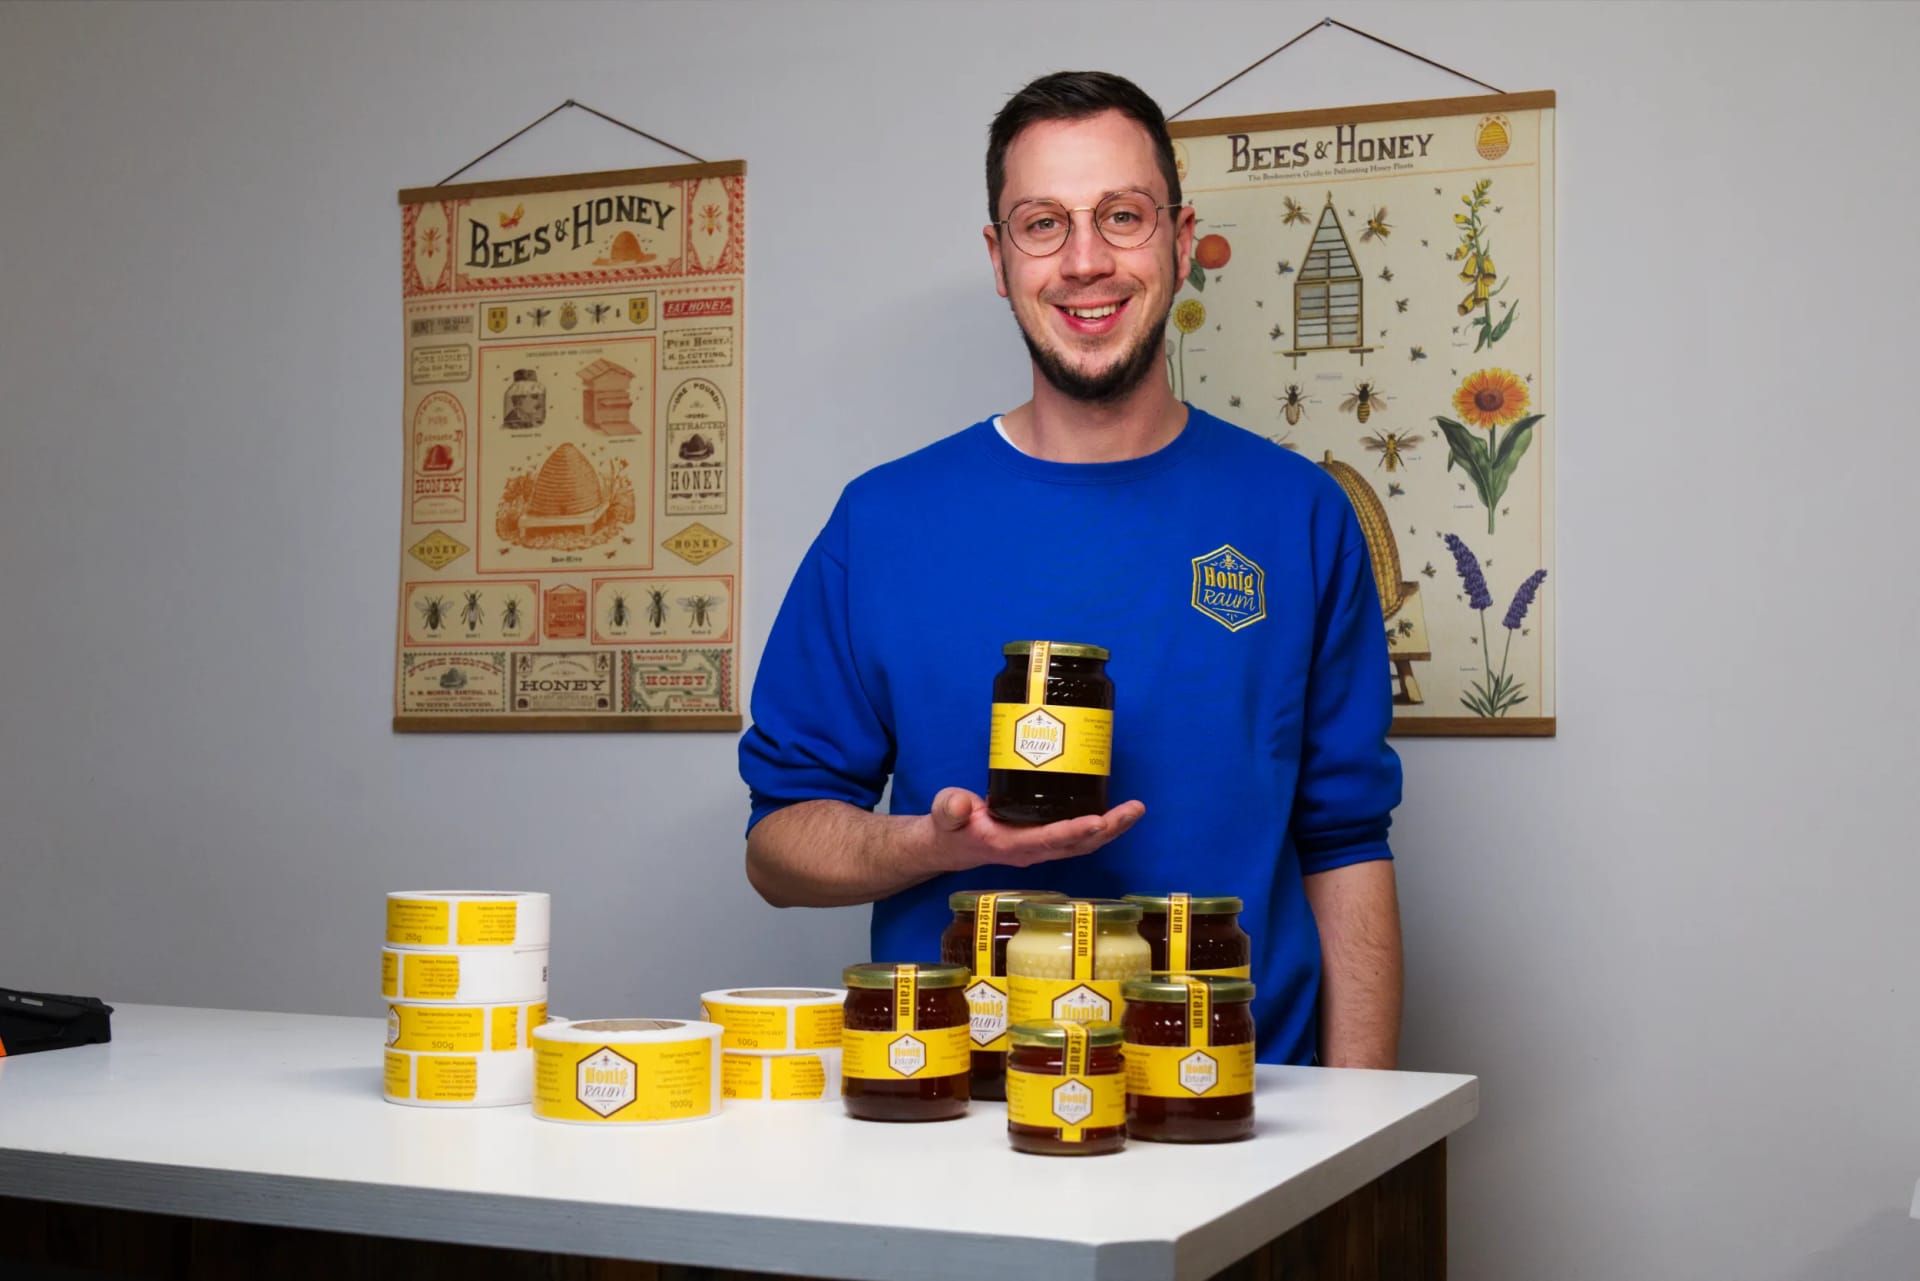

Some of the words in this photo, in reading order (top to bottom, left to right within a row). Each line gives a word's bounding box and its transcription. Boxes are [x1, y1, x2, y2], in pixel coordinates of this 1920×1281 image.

[1226, 133, 1310, 173] BEES
[1314, 141, 1333, 160] &
[1334, 124, 1434, 164] HONEY
[464, 218, 552, 268] BEES
[554, 217, 570, 242] &
[571, 195, 675, 250] HONEY
[667, 302, 688, 313] EAT
[688, 300, 727, 312] HONEY
[693, 383, 720, 404] POUND
[415, 477, 463, 494] HONEY
[670, 469, 724, 491] HONEY
[419, 545, 457, 555] HONEY
[675, 538, 718, 549] HONEY
[1204, 566, 1255, 595] Honig
[519, 679, 607, 691] HONEY
[646, 675, 705, 686] HONEY
[1021, 725, 1058, 742] Honig
[970, 1016, 1002, 1029] aum
[431, 1041, 454, 1051] 500g
[737, 1038, 759, 1048] 500g
[584, 1067, 628, 1086] Honig
[670, 1099, 694, 1109] 1000g
